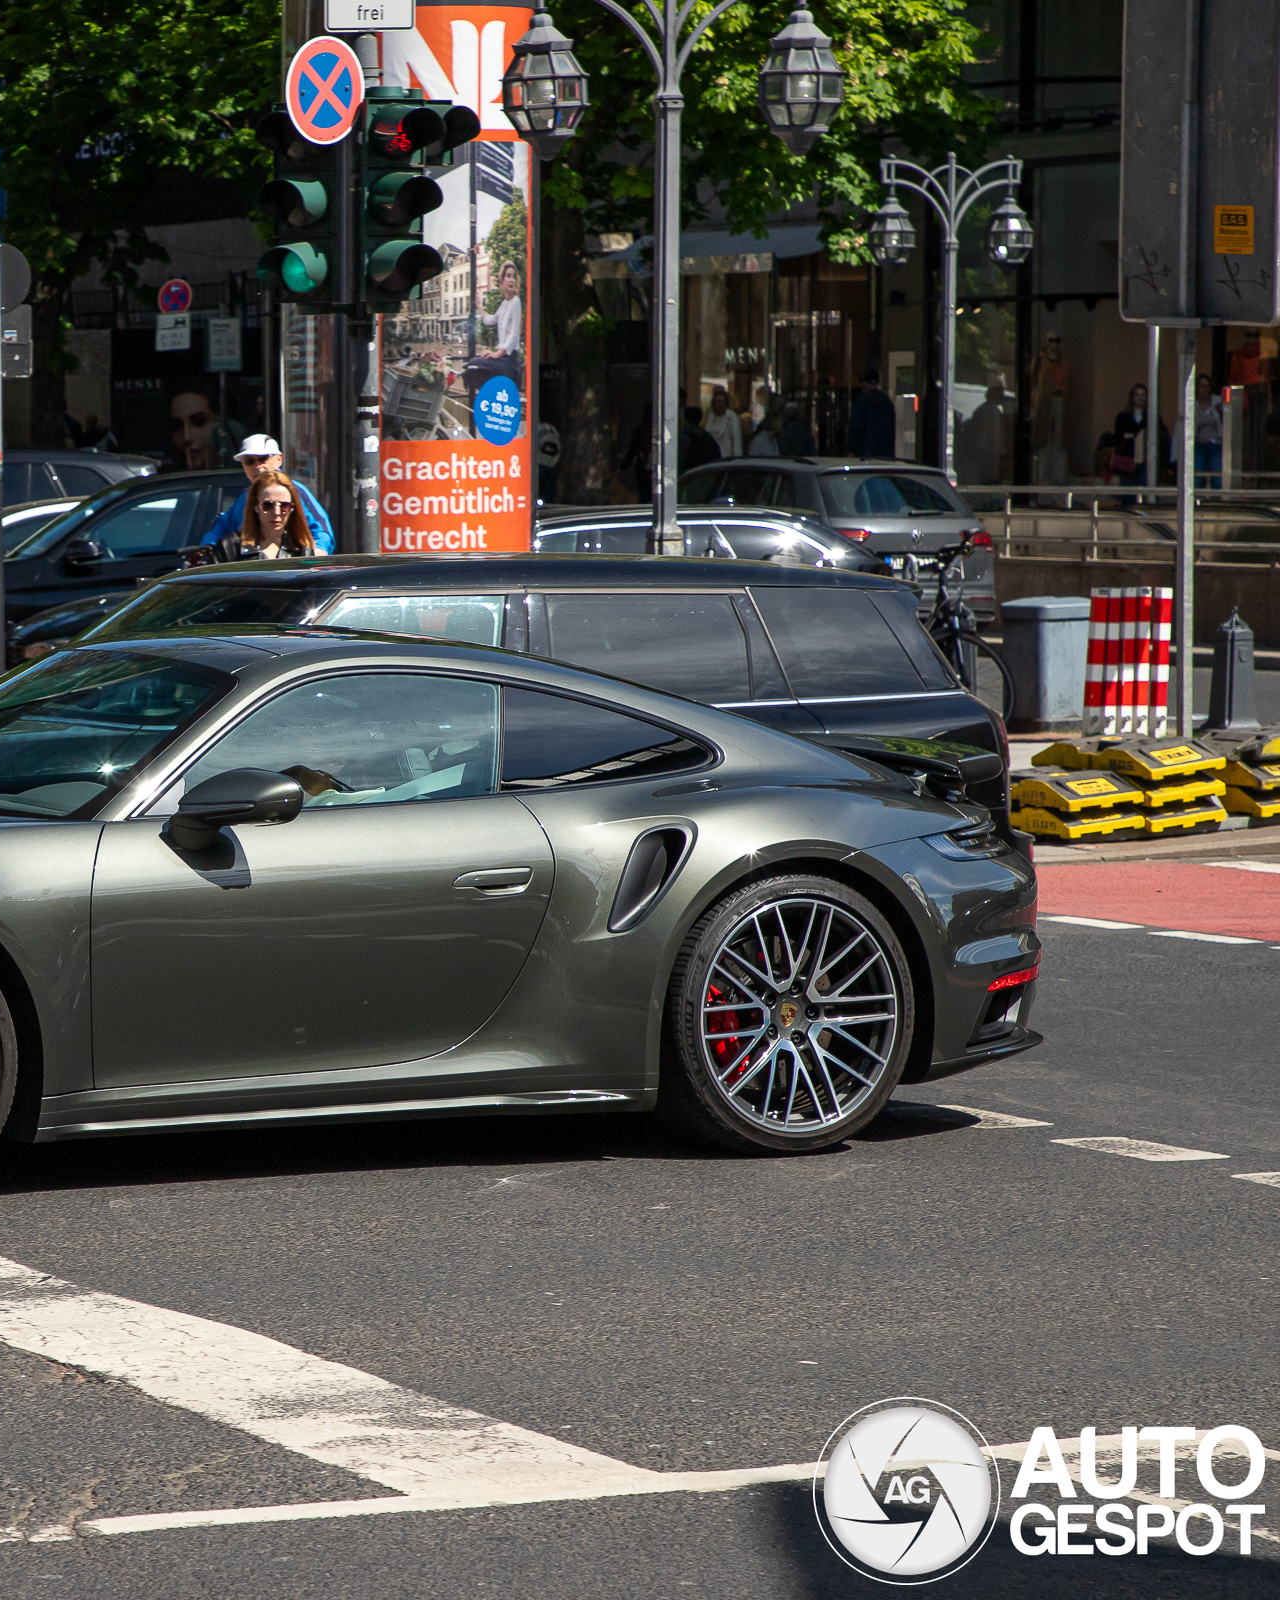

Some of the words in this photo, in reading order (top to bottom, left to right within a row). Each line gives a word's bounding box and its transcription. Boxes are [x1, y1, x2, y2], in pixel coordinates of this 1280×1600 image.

[357, 5, 384, 21] frei
[479, 400, 490, 412] €
[495, 388, 509, 403] ab
[382, 452, 505, 480] Grachten
[508, 454, 521, 478] &
[382, 485, 514, 516] Gemütlich
[382, 521, 488, 550] Utrecht
